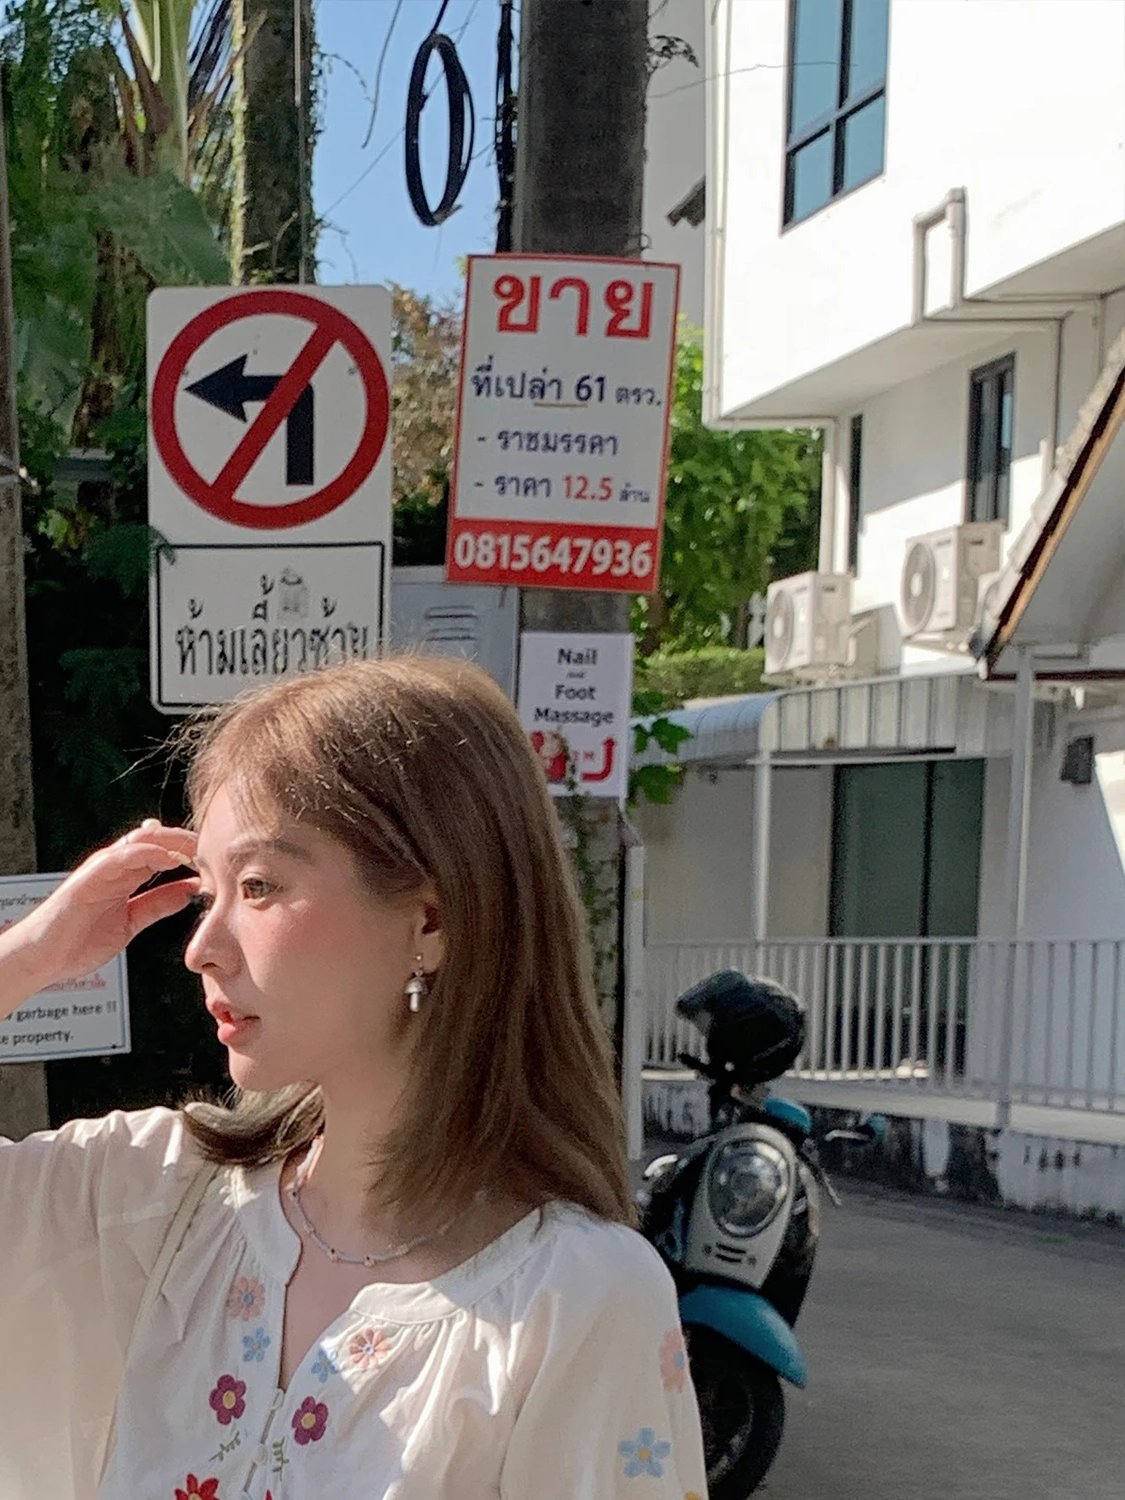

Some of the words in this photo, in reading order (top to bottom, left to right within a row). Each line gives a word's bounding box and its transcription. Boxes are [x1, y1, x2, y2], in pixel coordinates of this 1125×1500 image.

[493, 274, 654, 339] ขาย
[470, 355, 563, 400] ที่เปล่า
[575, 375, 607, 402] 61
[494, 475, 552, 497] ราคา
[563, 476, 613, 502] 12.5
[455, 531, 653, 578] 0815647936
[176, 573, 369, 675] ห้ามเลี้ยวซ้าย
[557, 648, 598, 665] Nail
[555, 684, 596, 700] Foot
[534, 707, 615, 728] Massage
[16, 1007, 70, 1022] garbage
[72, 1004, 103, 1016] here
[13, 1030, 74, 1047] property.
